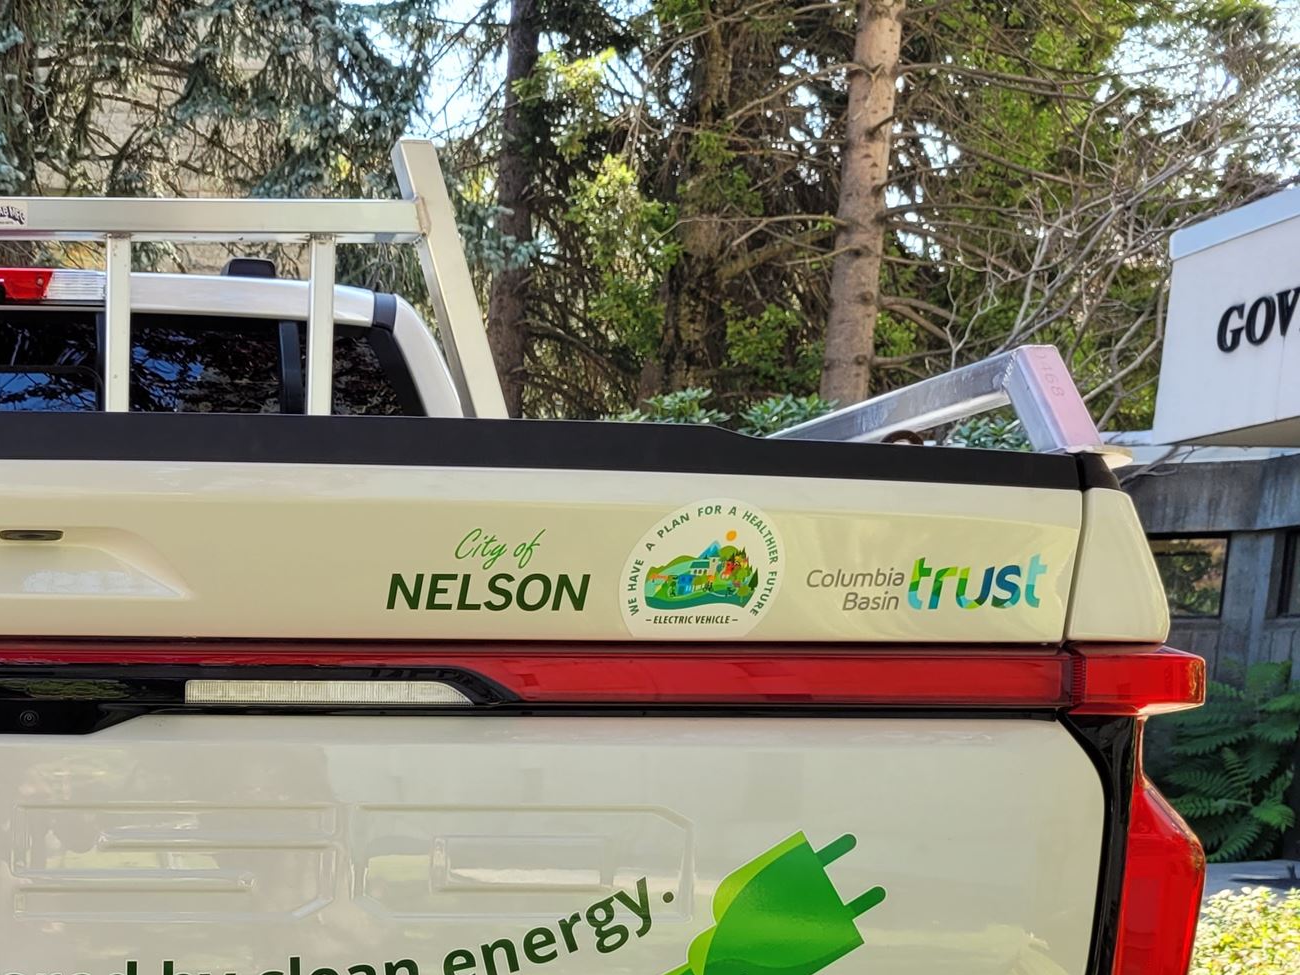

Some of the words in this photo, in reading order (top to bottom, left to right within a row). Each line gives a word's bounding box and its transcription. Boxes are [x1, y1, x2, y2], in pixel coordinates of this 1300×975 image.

[697, 505, 722, 517] FOR
[728, 506, 737, 516] A
[656, 513, 690, 538] PLAN
[645, 542, 656, 551] A
[742, 510, 779, 564] HEALTHIER
[455, 528, 507, 570] City
[513, 528, 546, 569] of
[627, 559, 644, 591] HAVE
[806, 568, 905, 588] Columbia
[907, 553, 1048, 610] trust
[386, 573, 591, 612] NELSON
[749, 571, 778, 616] FUTURE
[842, 592, 900, 611] Basin
[627, 597, 640, 616] WE
[653, 615, 693, 624] ELECTRIC
[695, 615, 731, 624] VEHICLE
